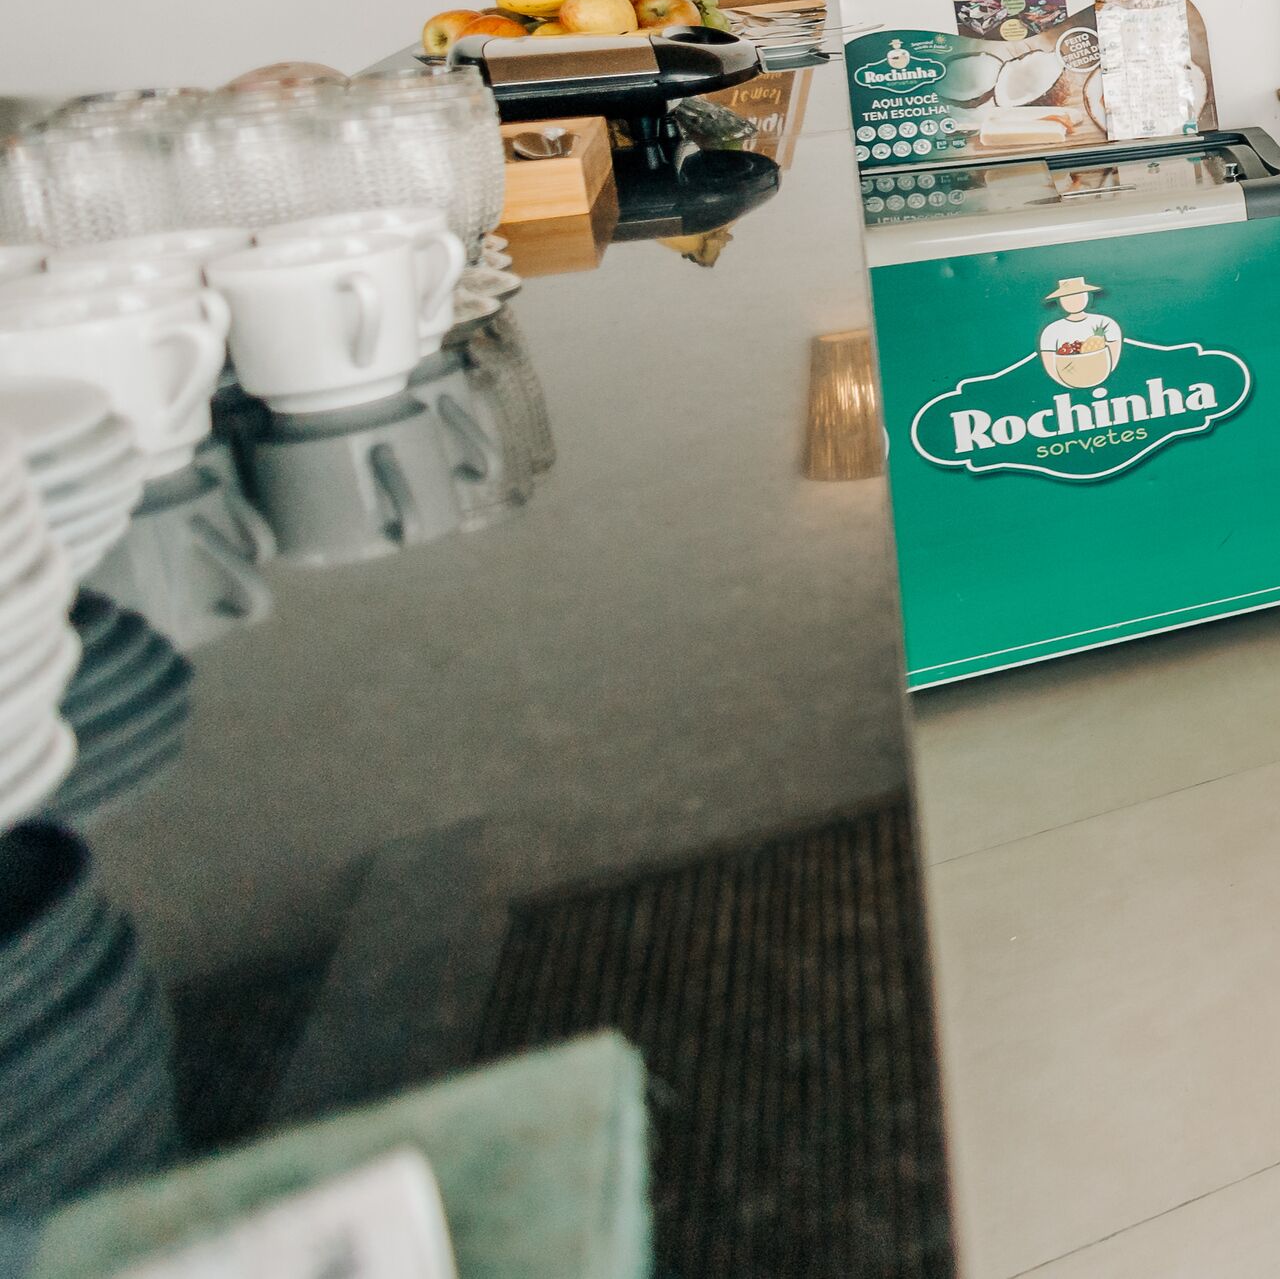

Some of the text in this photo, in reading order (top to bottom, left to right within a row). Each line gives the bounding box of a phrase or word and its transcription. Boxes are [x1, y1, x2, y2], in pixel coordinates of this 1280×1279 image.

[1064, 33, 1089, 47] FEITO
[1070, 40, 1091, 52] COM
[1063, 48, 1091, 63] FRUTA
[1065, 53, 1101, 68] VERDAD
[864, 67, 937, 83] Rochinha
[871, 92, 939, 109] AQUI VOCÊ
[862, 105, 950, 122] TEM ESCOLHA!
[950, 377, 1218, 454] Rochinha
[1036, 427, 1148, 459] sorvetes
